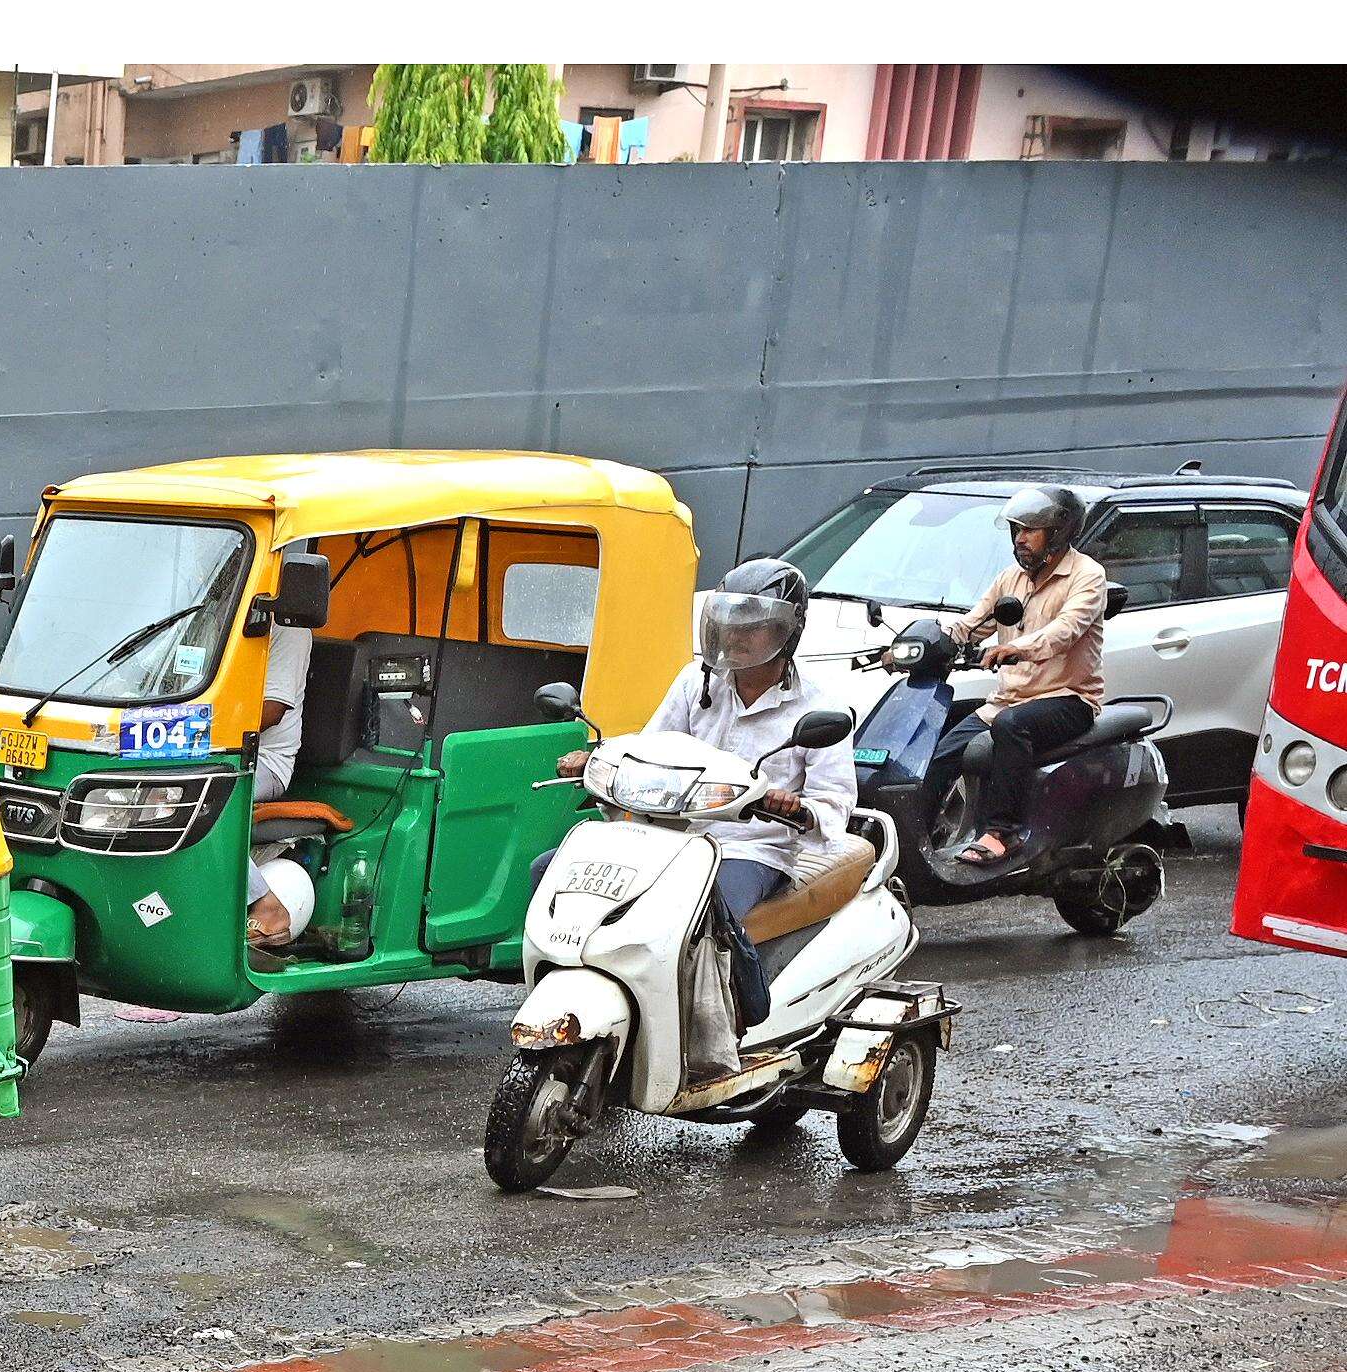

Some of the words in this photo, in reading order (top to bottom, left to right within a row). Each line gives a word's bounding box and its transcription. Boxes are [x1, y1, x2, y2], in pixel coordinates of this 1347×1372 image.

[7, 732, 38, 750] GJ27W
[129, 720, 207, 749] 1047
[5, 748, 36, 767] B6432
[7, 804, 36, 824] TVS
[584, 863, 622, 881] GJ01
[566, 877, 623, 897] PJ6914
[138, 902, 165, 917] CNG
[550, 933, 582, 947] 6914
